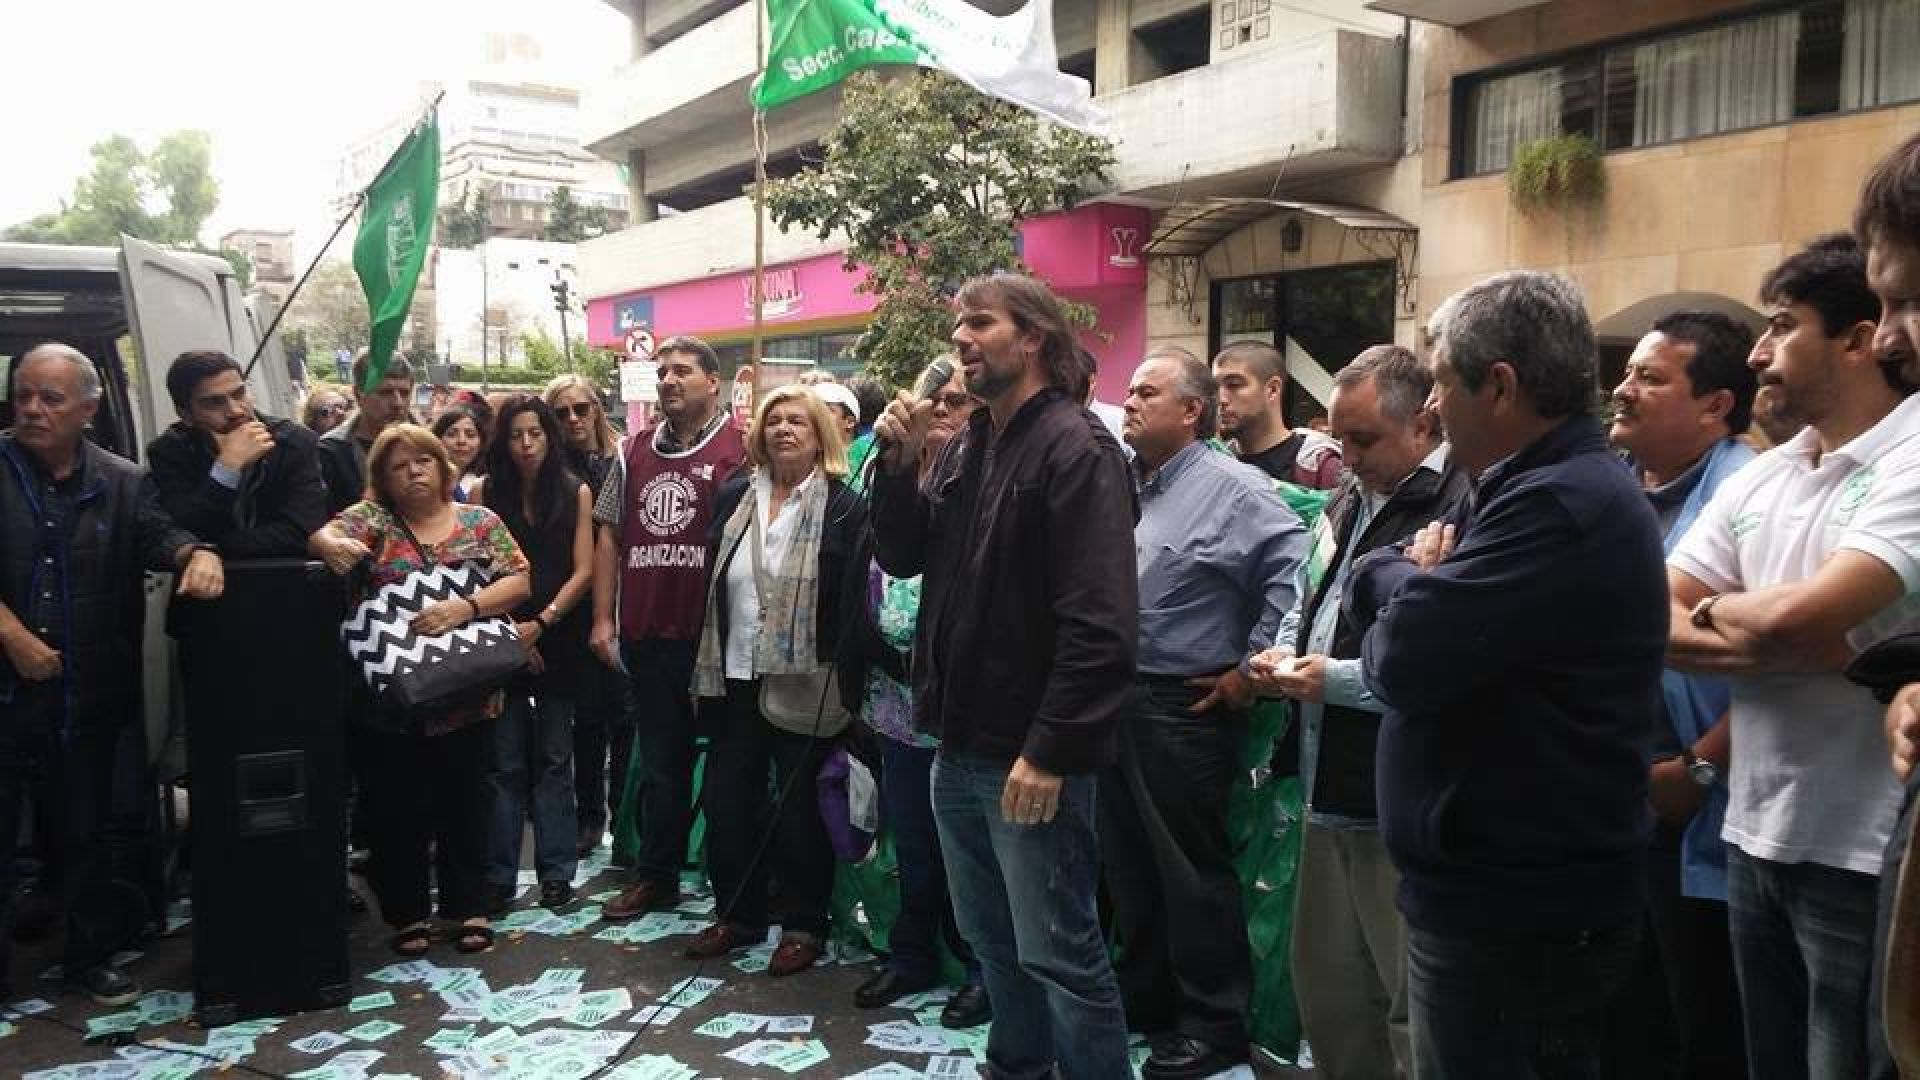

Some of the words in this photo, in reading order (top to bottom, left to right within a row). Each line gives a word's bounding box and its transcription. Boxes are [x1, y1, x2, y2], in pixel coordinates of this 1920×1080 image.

[782, 44, 845, 82] Secc.
[845, 25, 907, 50] Cap
[651, 486, 687, 524] ATE
